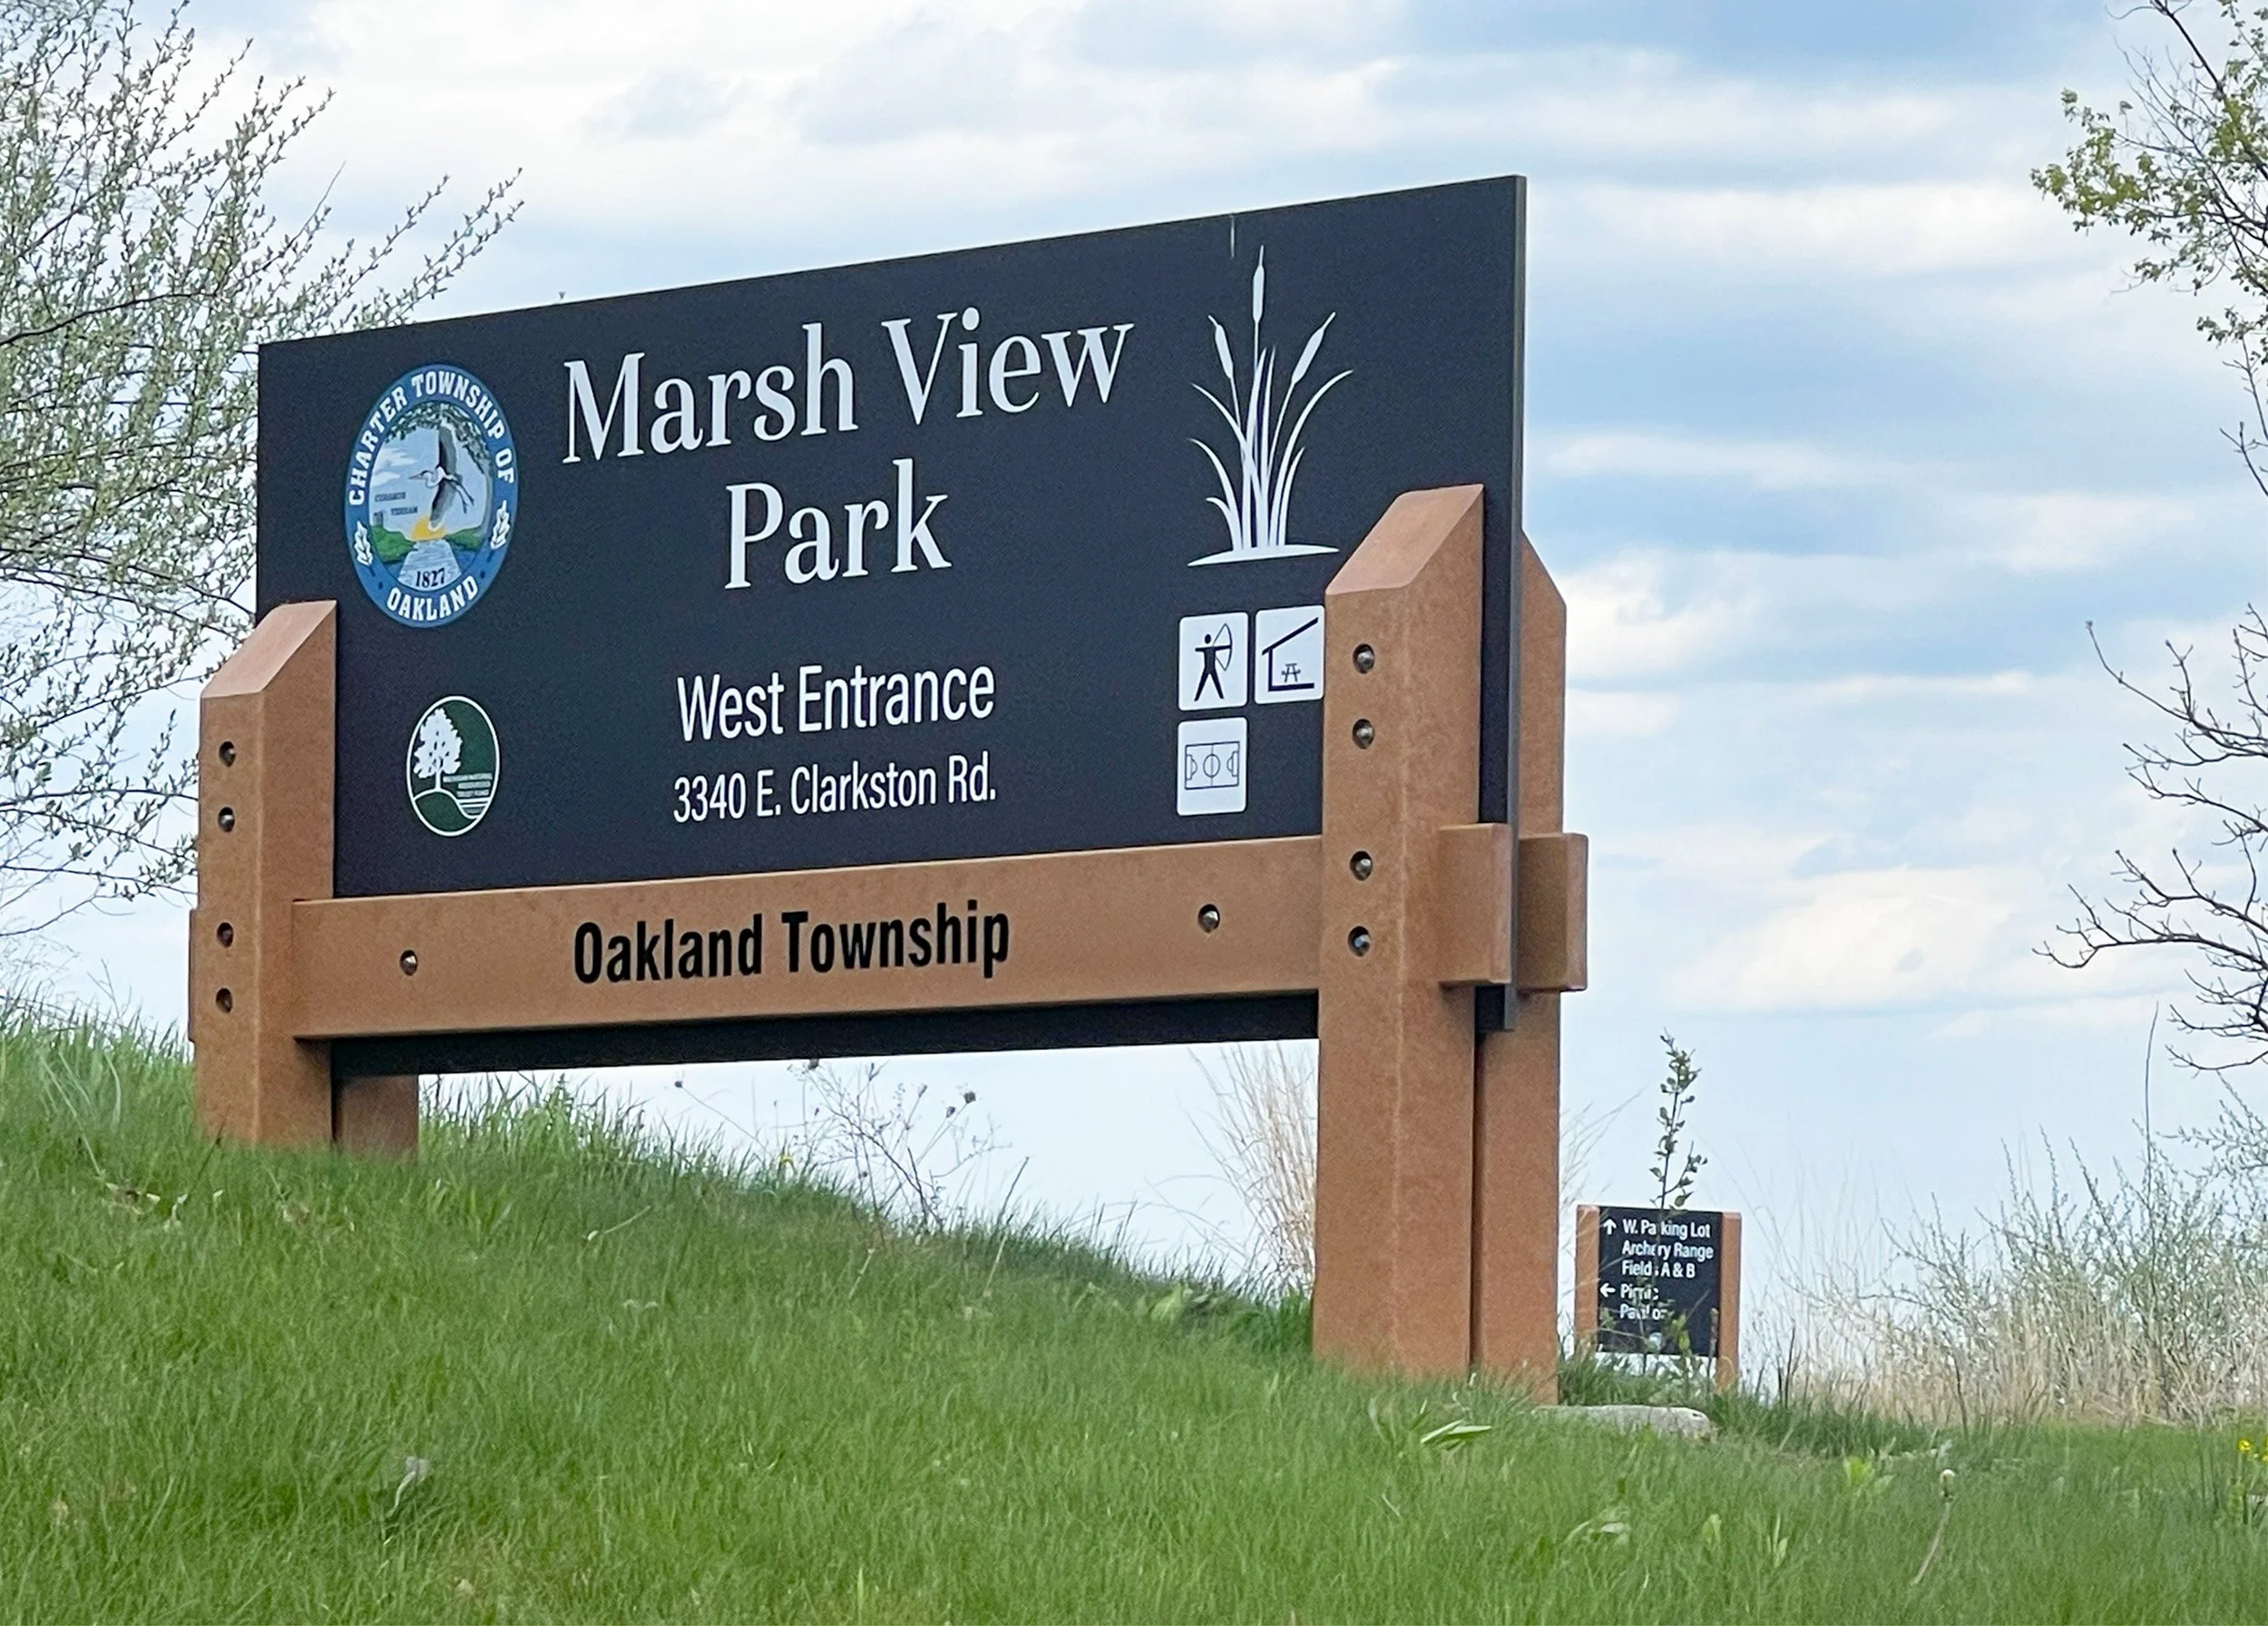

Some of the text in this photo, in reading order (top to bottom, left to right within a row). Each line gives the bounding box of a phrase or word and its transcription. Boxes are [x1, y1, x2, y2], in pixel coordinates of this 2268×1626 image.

[562, 307, 1135, 464] Marsh View
[348, 370, 515, 505] CHARTER TOWNSHIP OF
[725, 458, 952, 589] Park
[386, 575, 479, 622] OAKLAND
[415, 568, 446, 588] 1827
[677, 665, 994, 741] West Entrance
[673, 750, 997, 822] 3340 E. Clarkston Rd.
[574, 899, 1010, 984] Oakland Township
[1622, 1219, 1711, 1240] W. Paking Lot
[1673, 1242, 1715, 1262] Range
[1661, 1262, 1671, 1277] A
[1673, 1262, 1684, 1278] &
[1686, 1263, 1696, 1278] B
